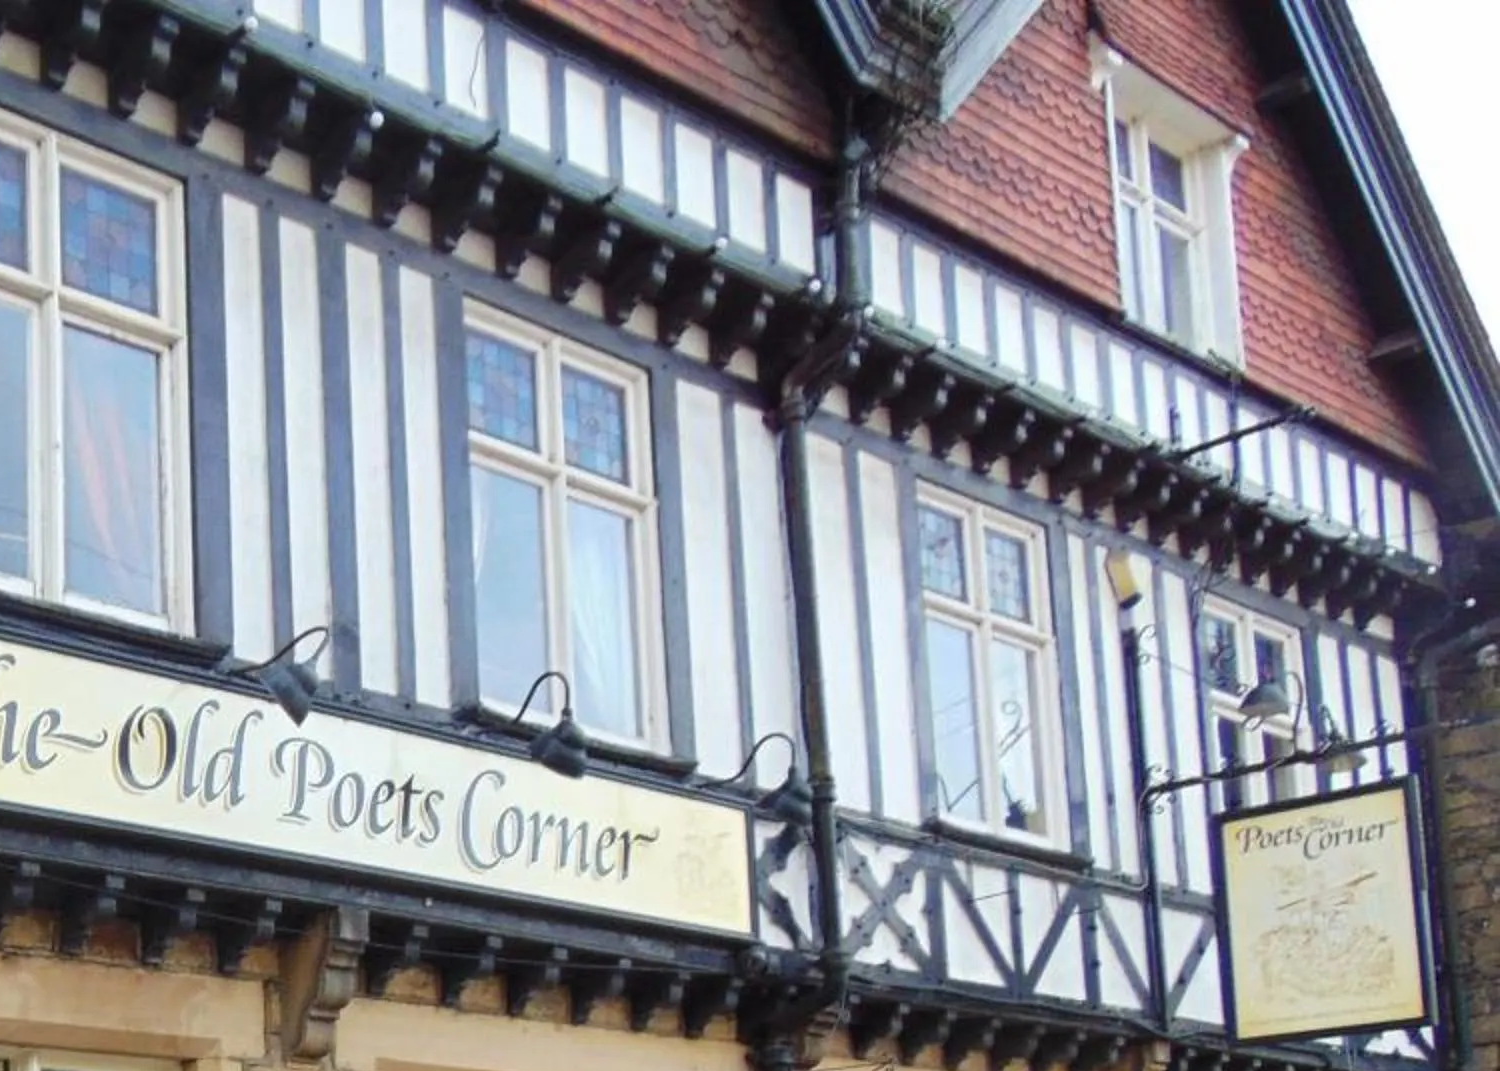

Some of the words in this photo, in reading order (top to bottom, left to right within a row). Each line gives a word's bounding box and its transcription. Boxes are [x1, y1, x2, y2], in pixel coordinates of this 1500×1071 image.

[115, 700, 264, 808] Old
[270, 736, 445, 849] Poets
[459, 769, 661, 882] Corner
[1235, 824, 1305, 854] Poets
[1302, 815, 1399, 861] Corner
